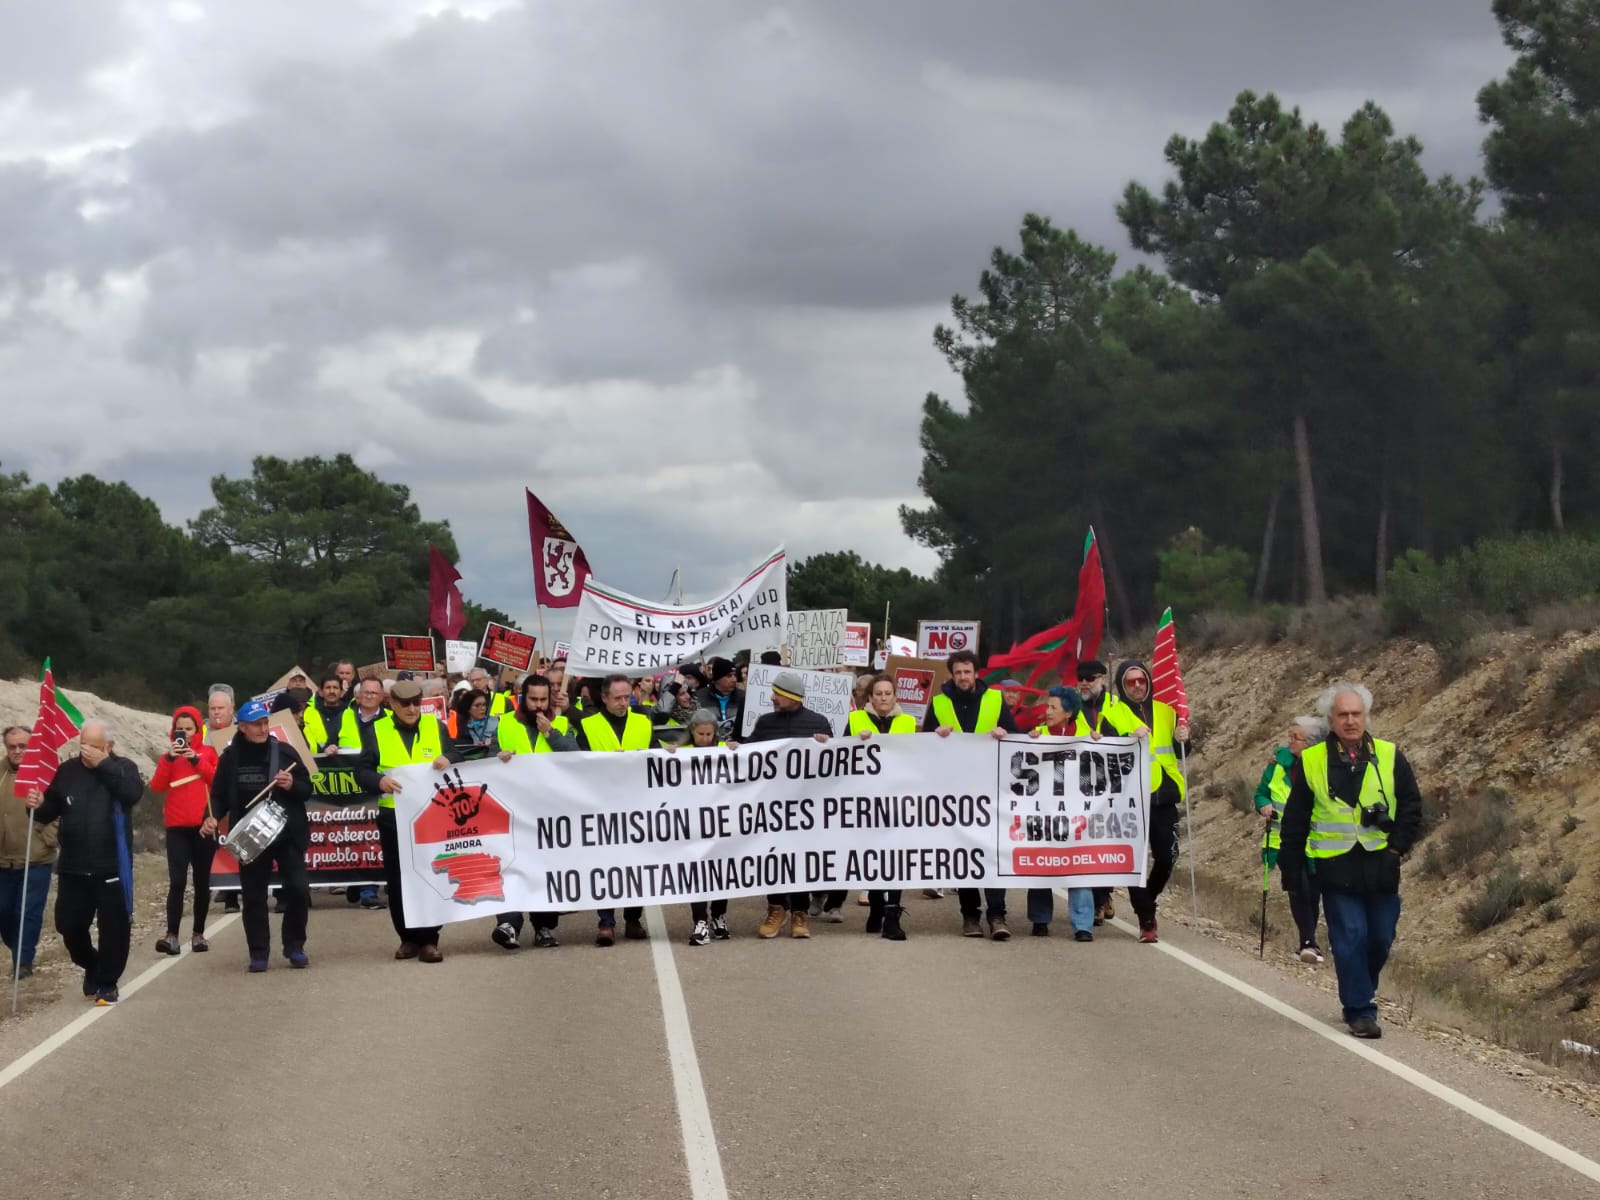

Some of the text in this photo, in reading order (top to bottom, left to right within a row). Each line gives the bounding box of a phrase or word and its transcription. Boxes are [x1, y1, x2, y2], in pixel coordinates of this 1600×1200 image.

[635, 613, 656, 628] EL
[588, 623, 623, 642] POR
[636, 627, 721, 646] NUESTRA
[897, 677, 919, 689] STOP
[647, 744, 882, 789] NO MALOS OLORES
[1010, 749, 1135, 797] STOP
[323, 806, 366, 823] salud
[537, 794, 991, 850] NO EMISIÓN DE GASES PERNICIOSOS
[446, 826, 479, 839] BIOGAS
[445, 839, 482, 852] ZAMORA
[312, 847, 358, 868] pueblo
[1019, 853, 1126, 866] EL CUBO DEL VINO
[546, 846, 986, 904] NO CONTAMINACIÓN DE ACUIFEROS
